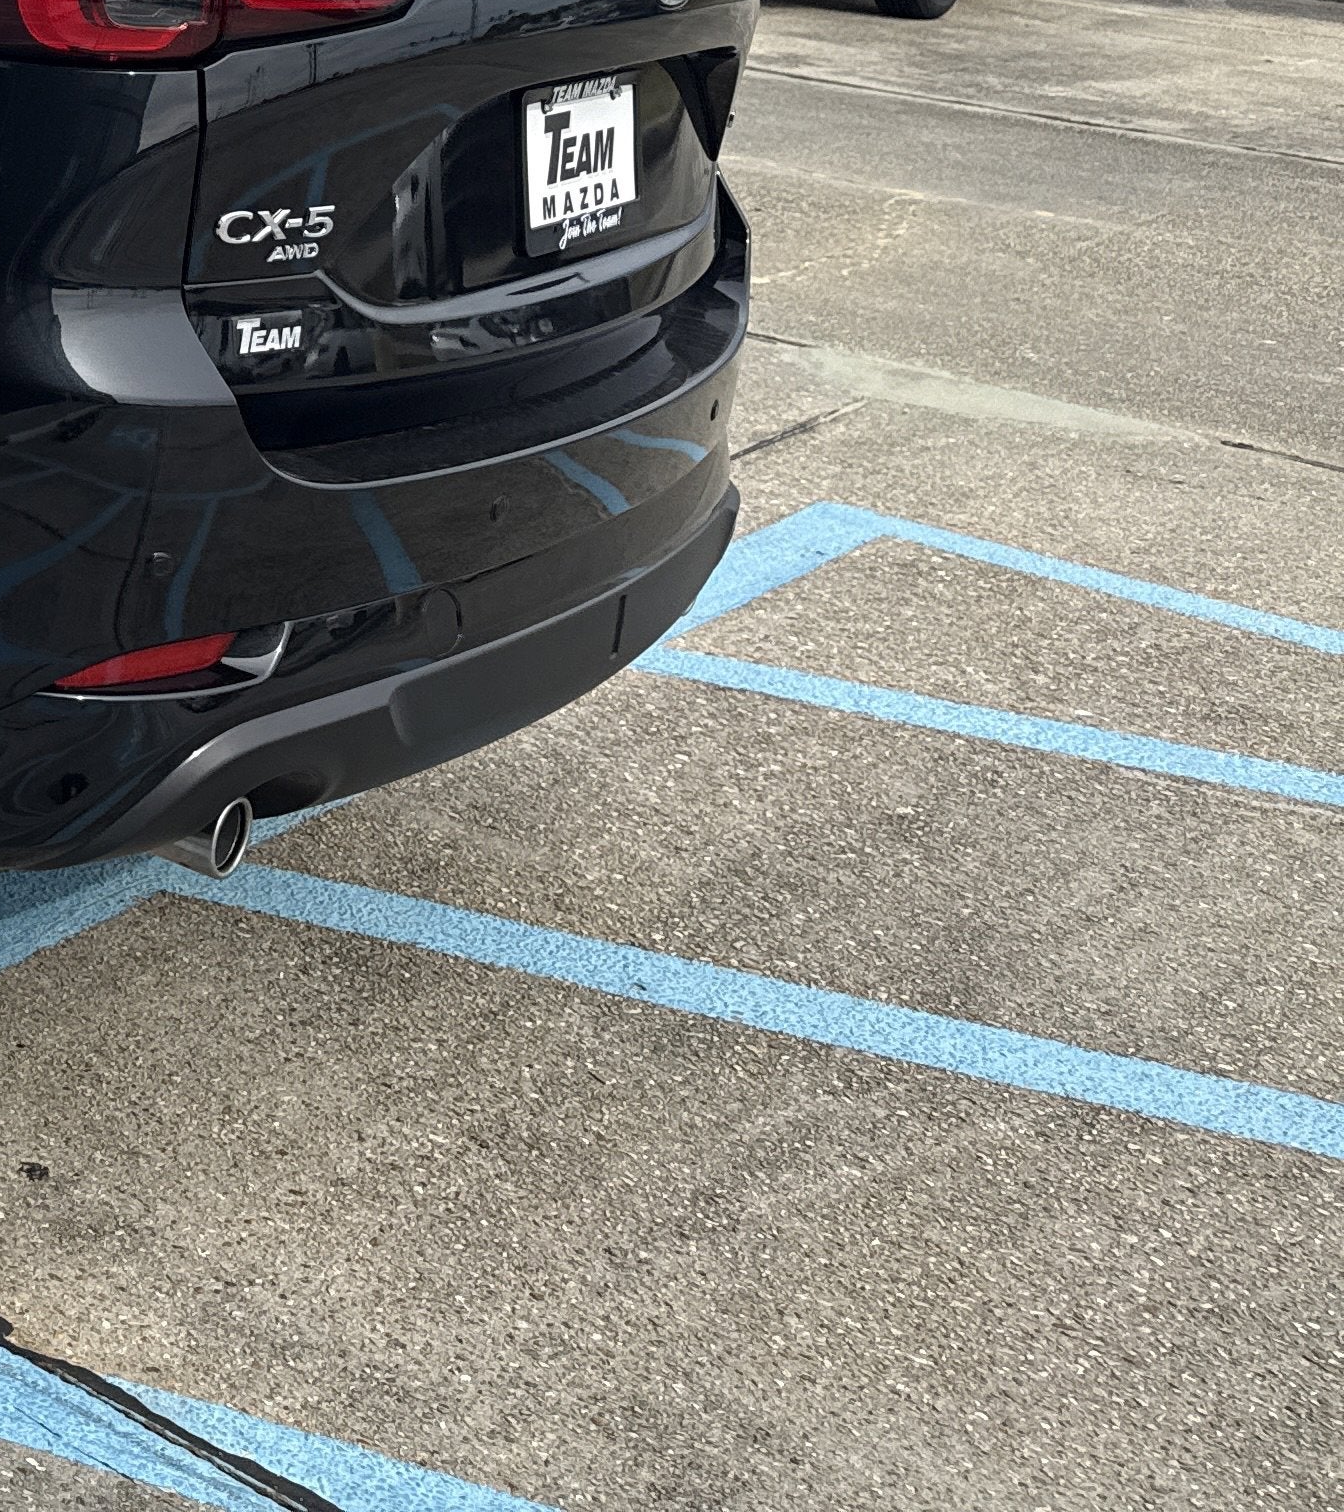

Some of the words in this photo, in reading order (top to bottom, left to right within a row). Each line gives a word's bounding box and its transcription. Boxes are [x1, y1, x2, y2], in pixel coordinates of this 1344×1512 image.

[552, 81, 584, 104] TEAM
[583, 76, 616, 100] MAZDA
[542, 178, 620, 220] MAZDA
[215, 205, 336, 245] CX-5
[559, 218, 581, 249] Join
[597, 206, 623, 232] Team!
[266, 242, 320, 262] AWD
